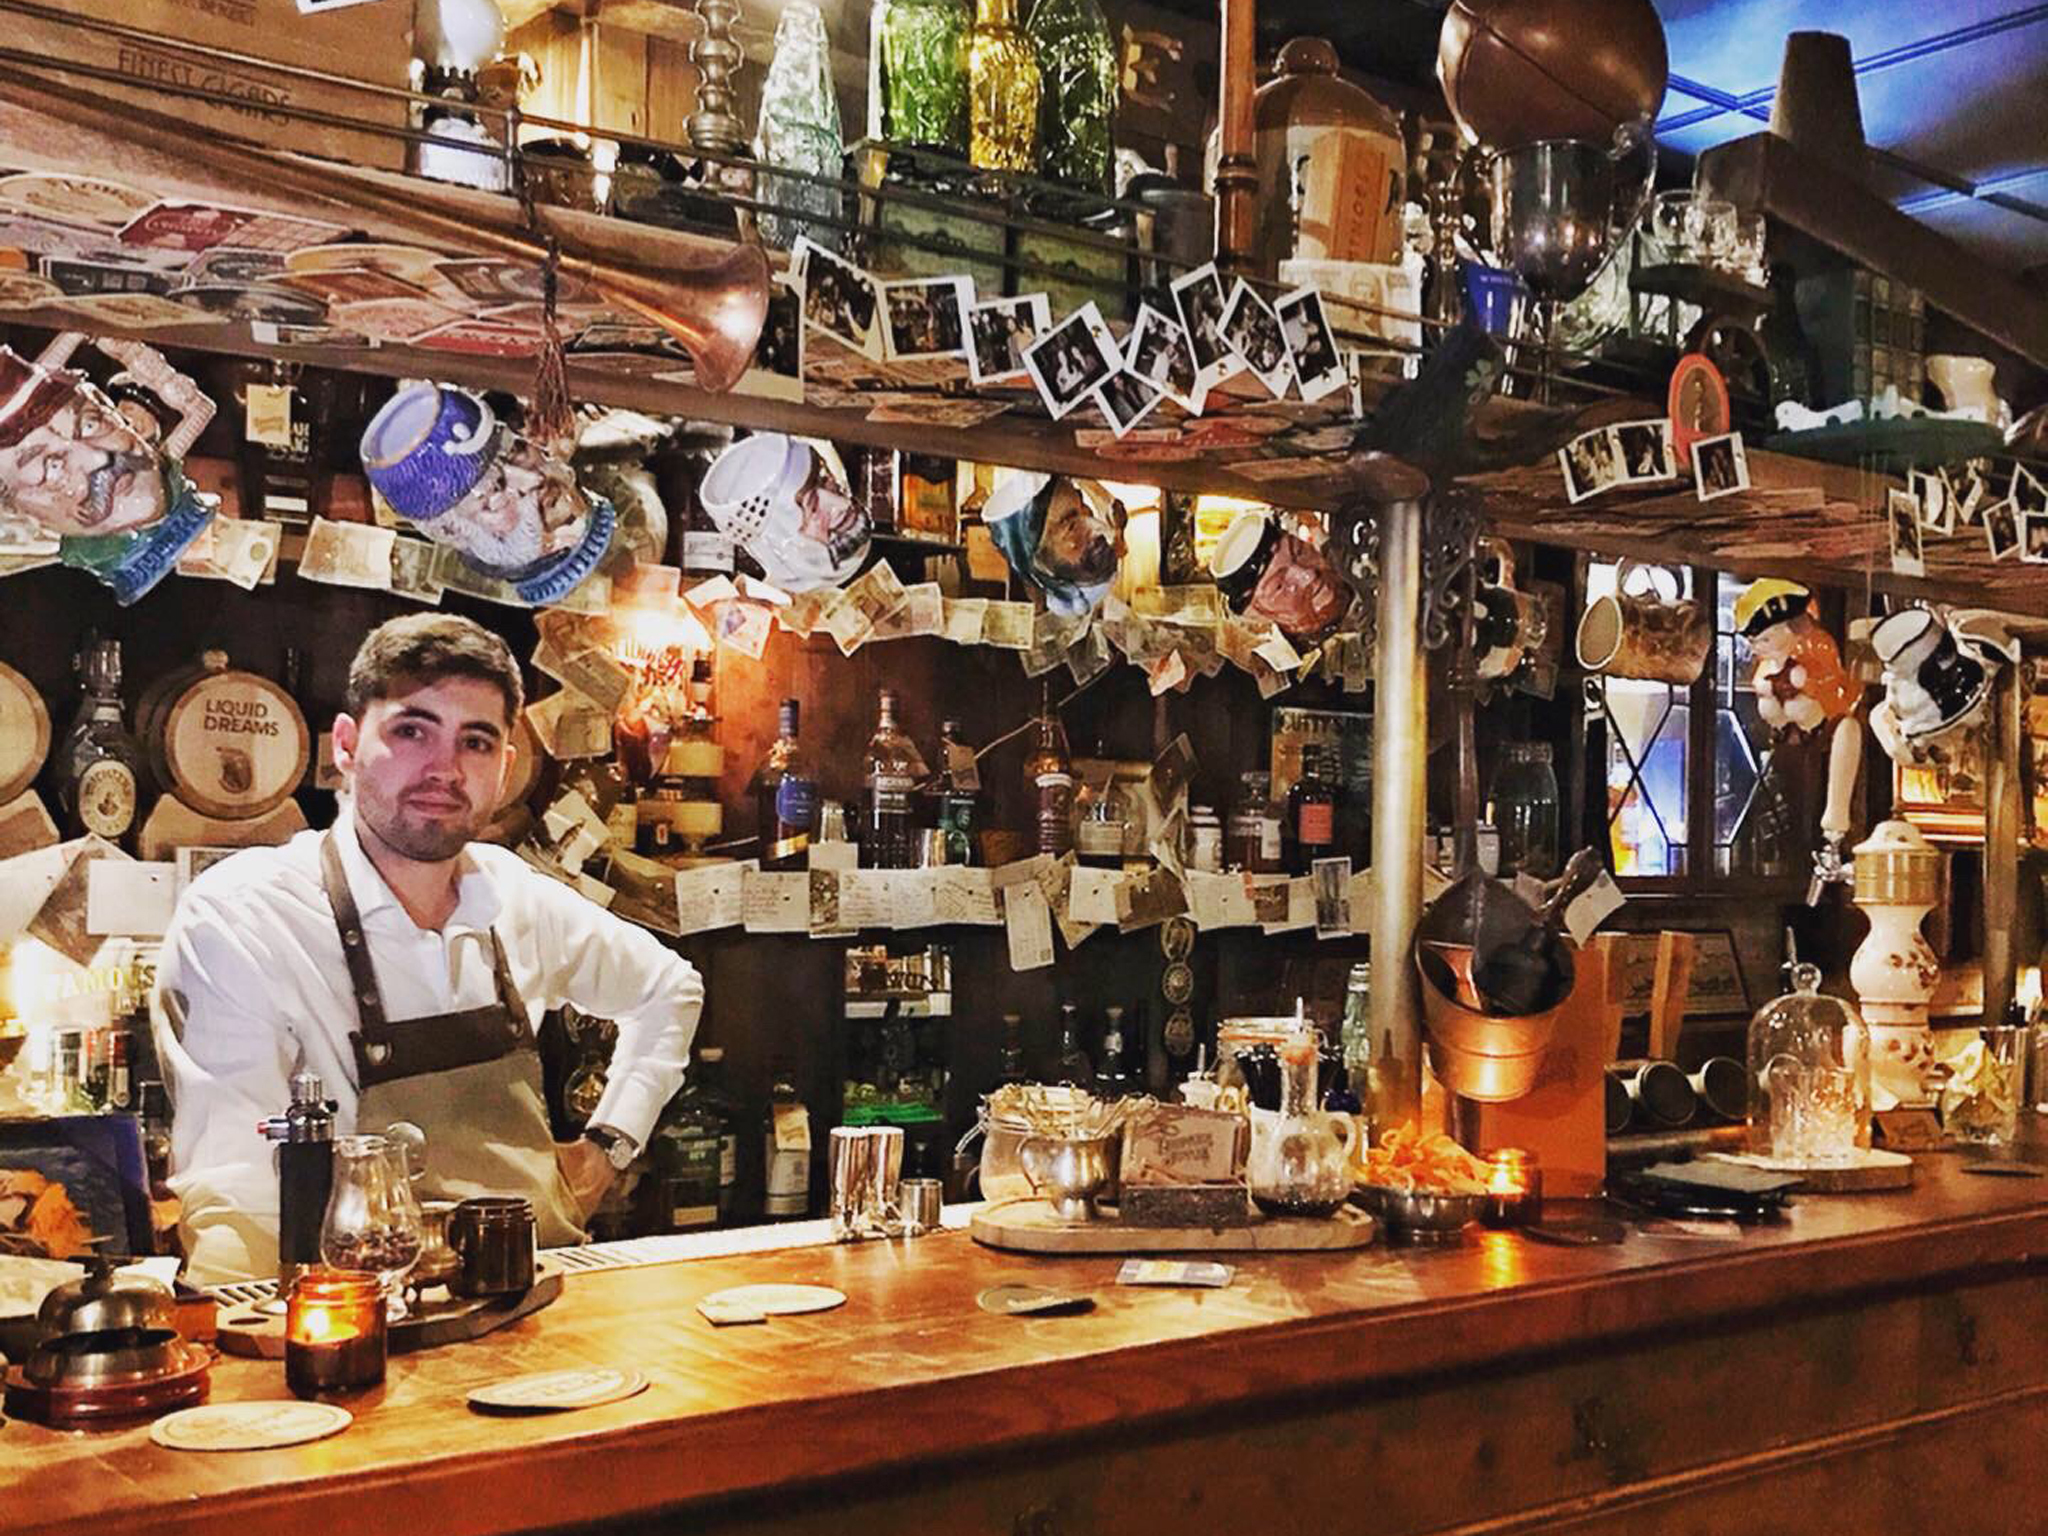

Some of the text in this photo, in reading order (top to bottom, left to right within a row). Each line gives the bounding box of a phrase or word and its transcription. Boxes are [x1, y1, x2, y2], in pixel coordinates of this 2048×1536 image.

[117, 48, 194, 96] FINEST
[205, 699, 268, 719] LIQUID
[204, 715, 280, 736] DREAMS
